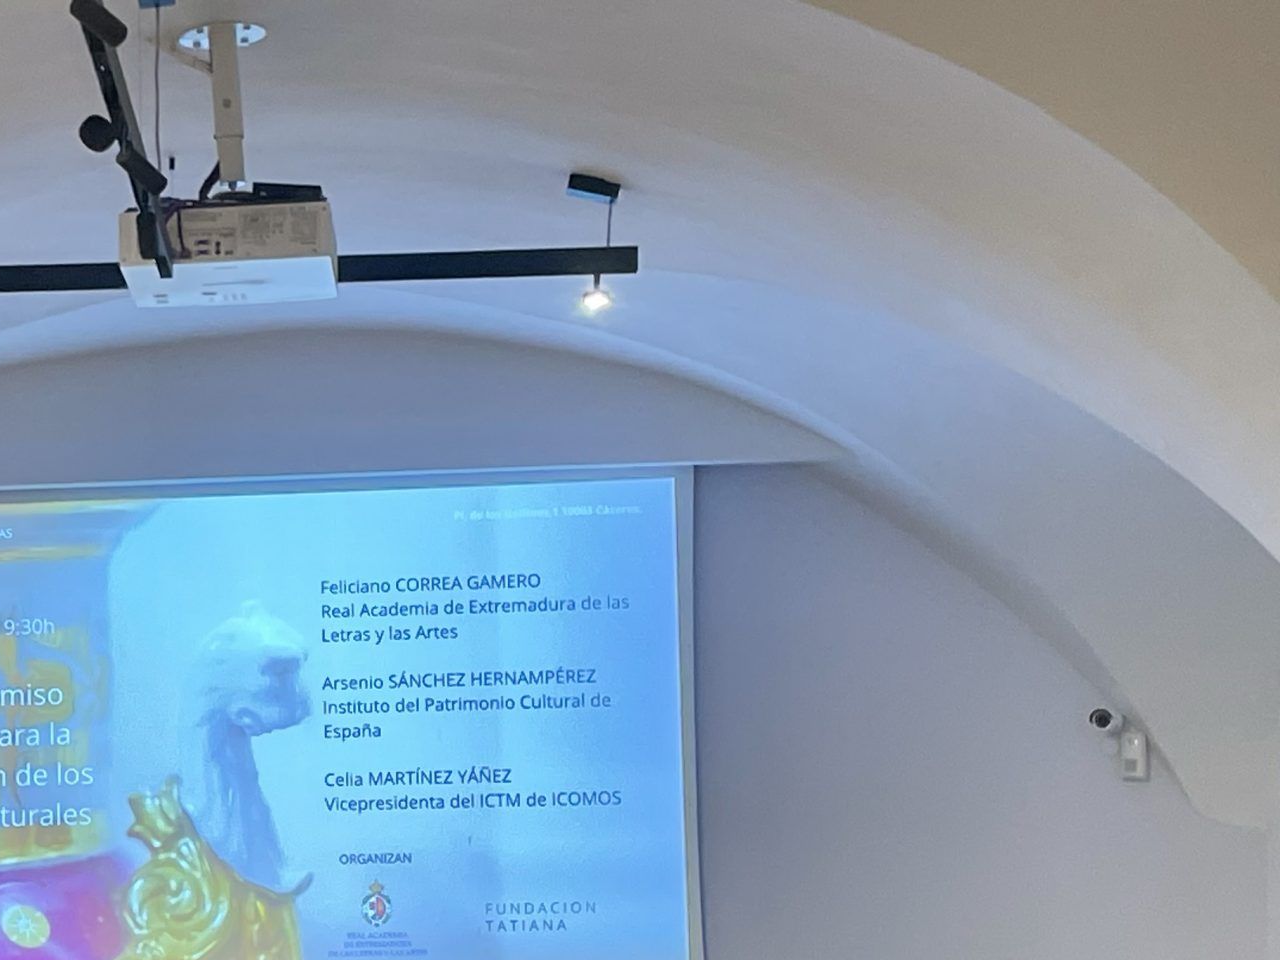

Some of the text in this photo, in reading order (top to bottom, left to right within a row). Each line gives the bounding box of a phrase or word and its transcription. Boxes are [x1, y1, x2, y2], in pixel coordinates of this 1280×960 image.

[321, 573, 541, 594] Feliciano CORREA GAMERO
[321, 594, 630, 618] Real Academia de Extremadura de las
[322, 624, 458, 645] Letras y las Artes
[322, 666, 597, 691] Arsenio SÁNCHEZ HERNAMPÉREZ
[323, 692, 612, 715] Instituto del Patrimonio Cultural de
[50, 722, 71, 745] la
[324, 723, 382, 742] España
[15, 763, 48, 787] de
[57, 761, 94, 786] los
[324, 765, 512, 788] Celia MARTÍNEZ YÁÑEZ
[325, 790, 622, 814] Vicepresidenta del ICTM de ICOMOS
[338, 852, 413, 865] ORGANIZAN
[484, 900, 597, 916] FUNDACION
[485, 917, 568, 933] TATIANA
